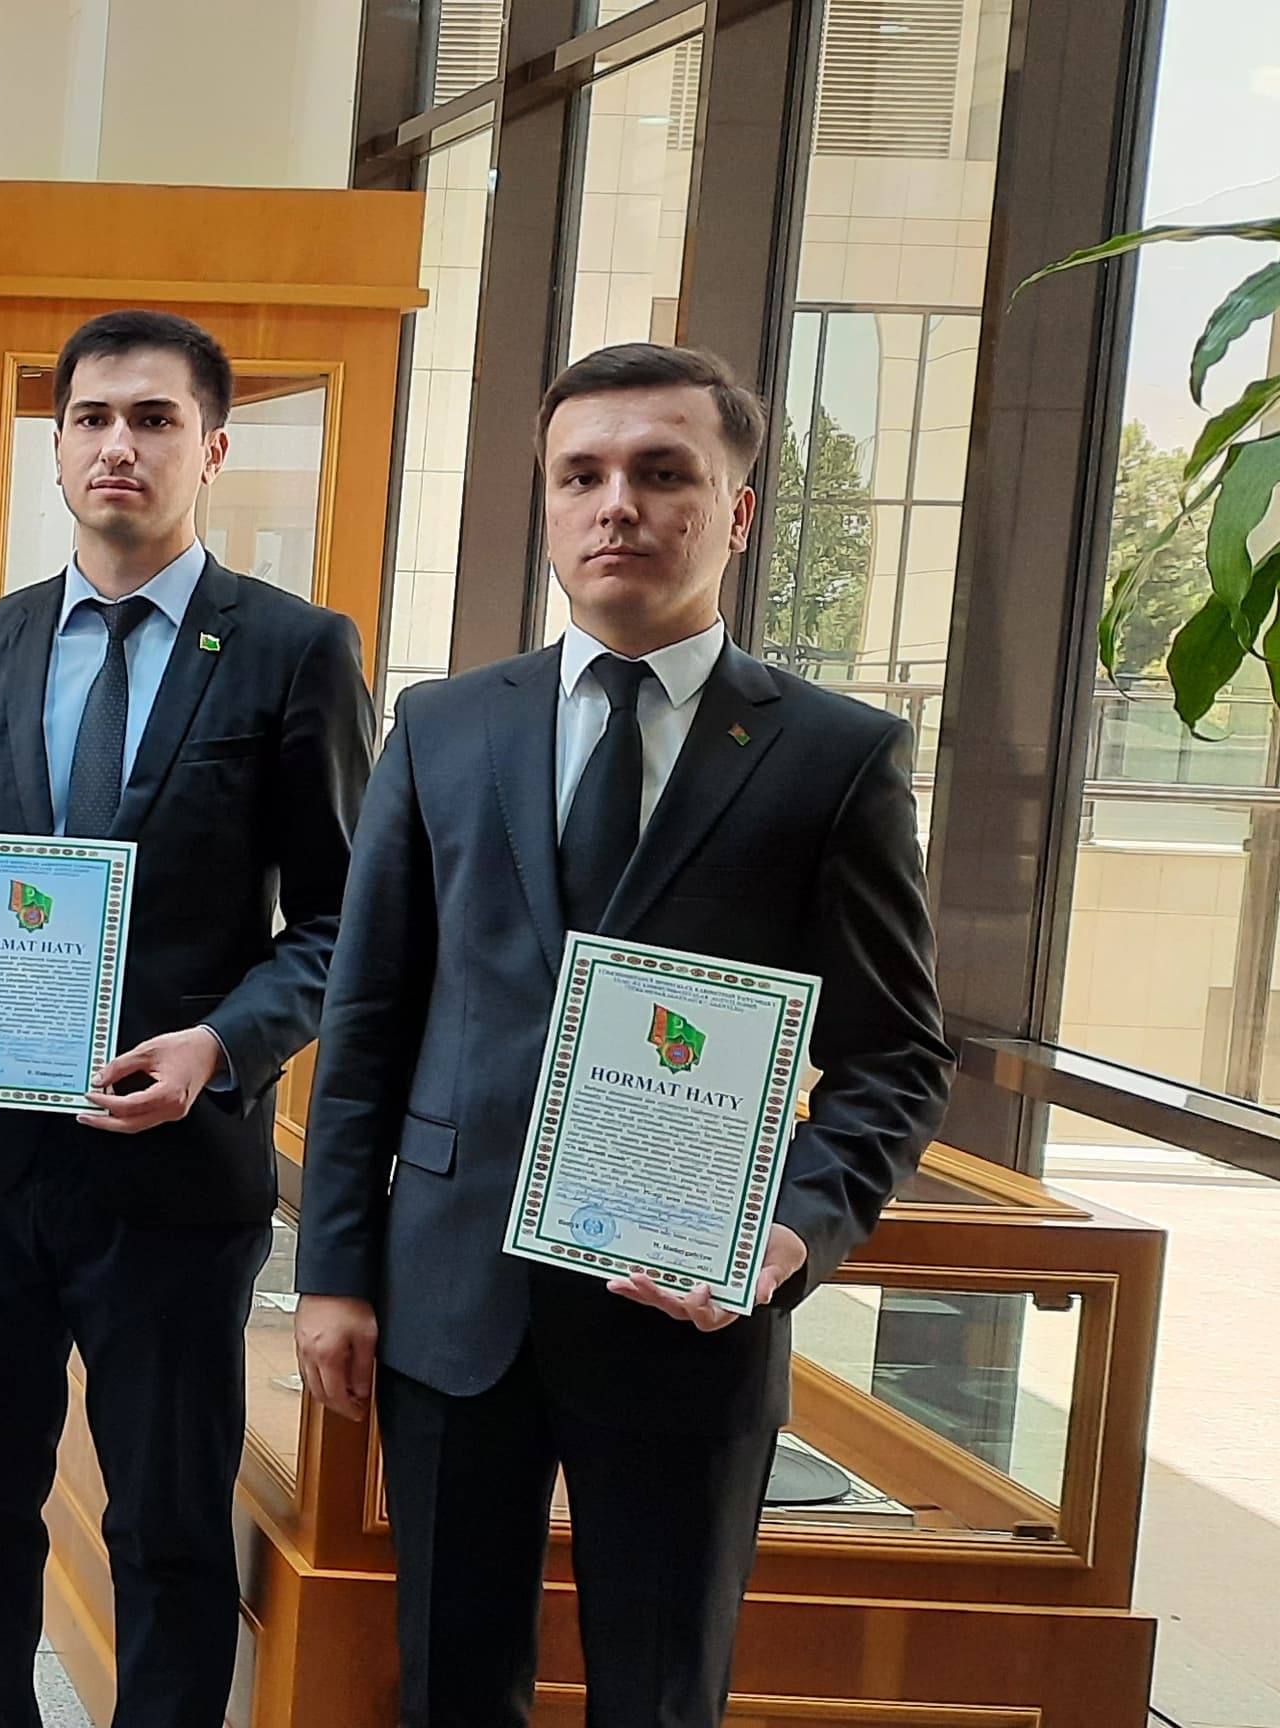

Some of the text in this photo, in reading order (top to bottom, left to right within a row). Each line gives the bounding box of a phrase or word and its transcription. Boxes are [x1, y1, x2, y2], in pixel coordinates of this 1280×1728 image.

[41, 940, 86, 955] HATY
[590, 1066, 744, 1111] HORMAT HATY
